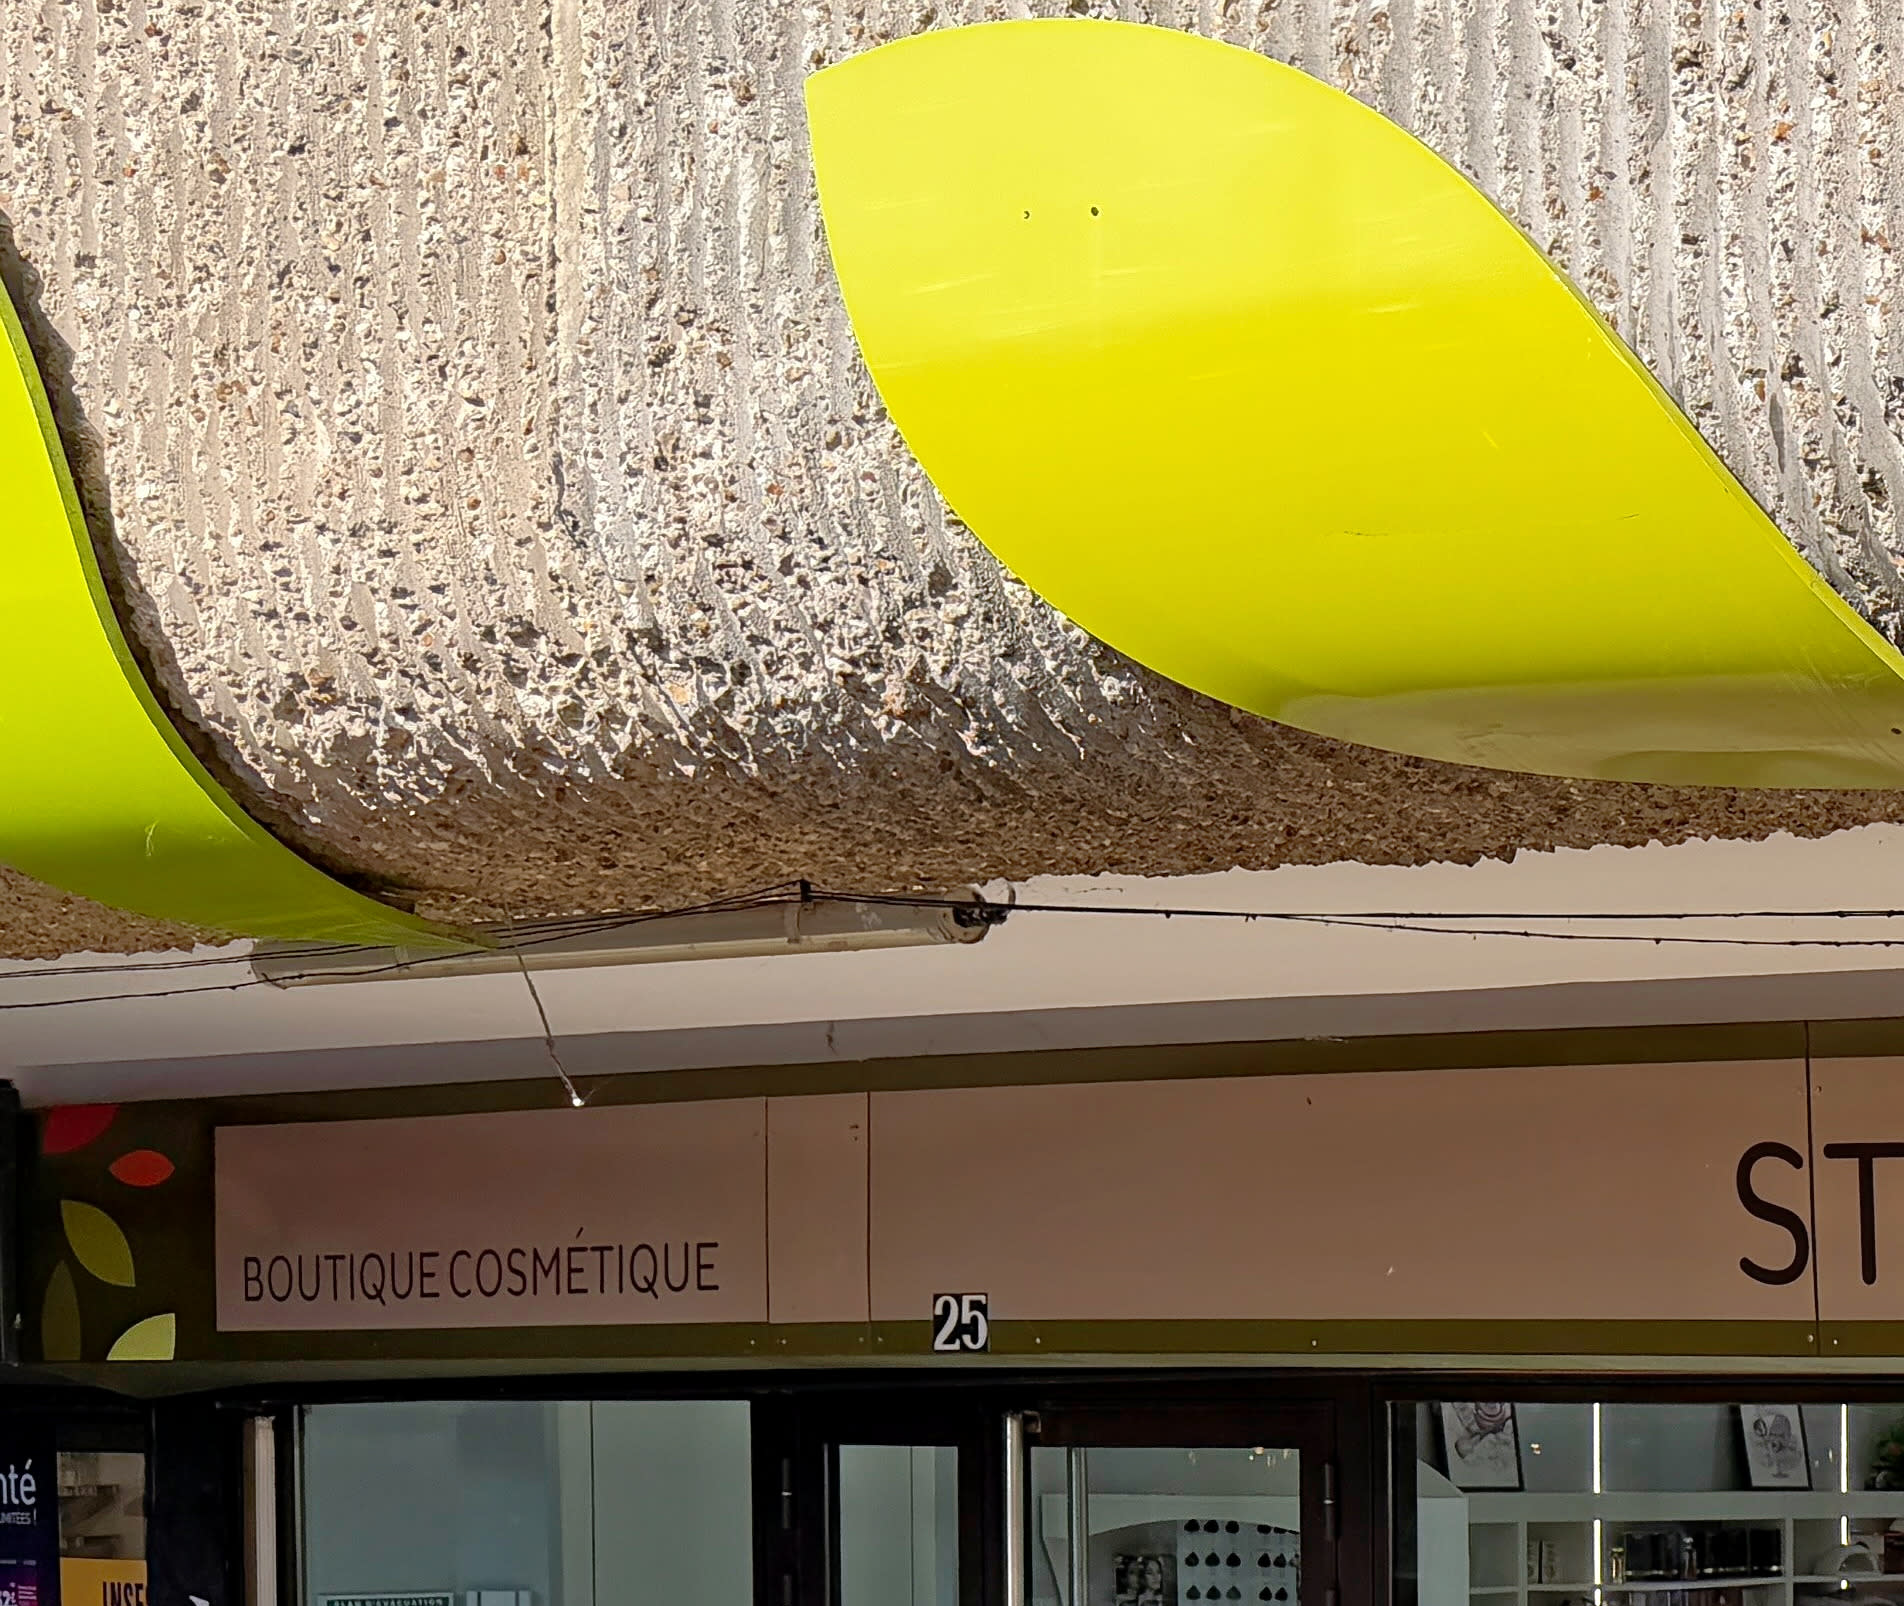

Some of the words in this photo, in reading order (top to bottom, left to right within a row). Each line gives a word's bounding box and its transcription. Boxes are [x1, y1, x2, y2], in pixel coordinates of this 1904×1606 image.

[242, 1250, 441, 1306] BOUTIQUE
[448, 1226, 721, 1301] COSMÉTIQUE
[932, 1294, 989, 1352] 25
